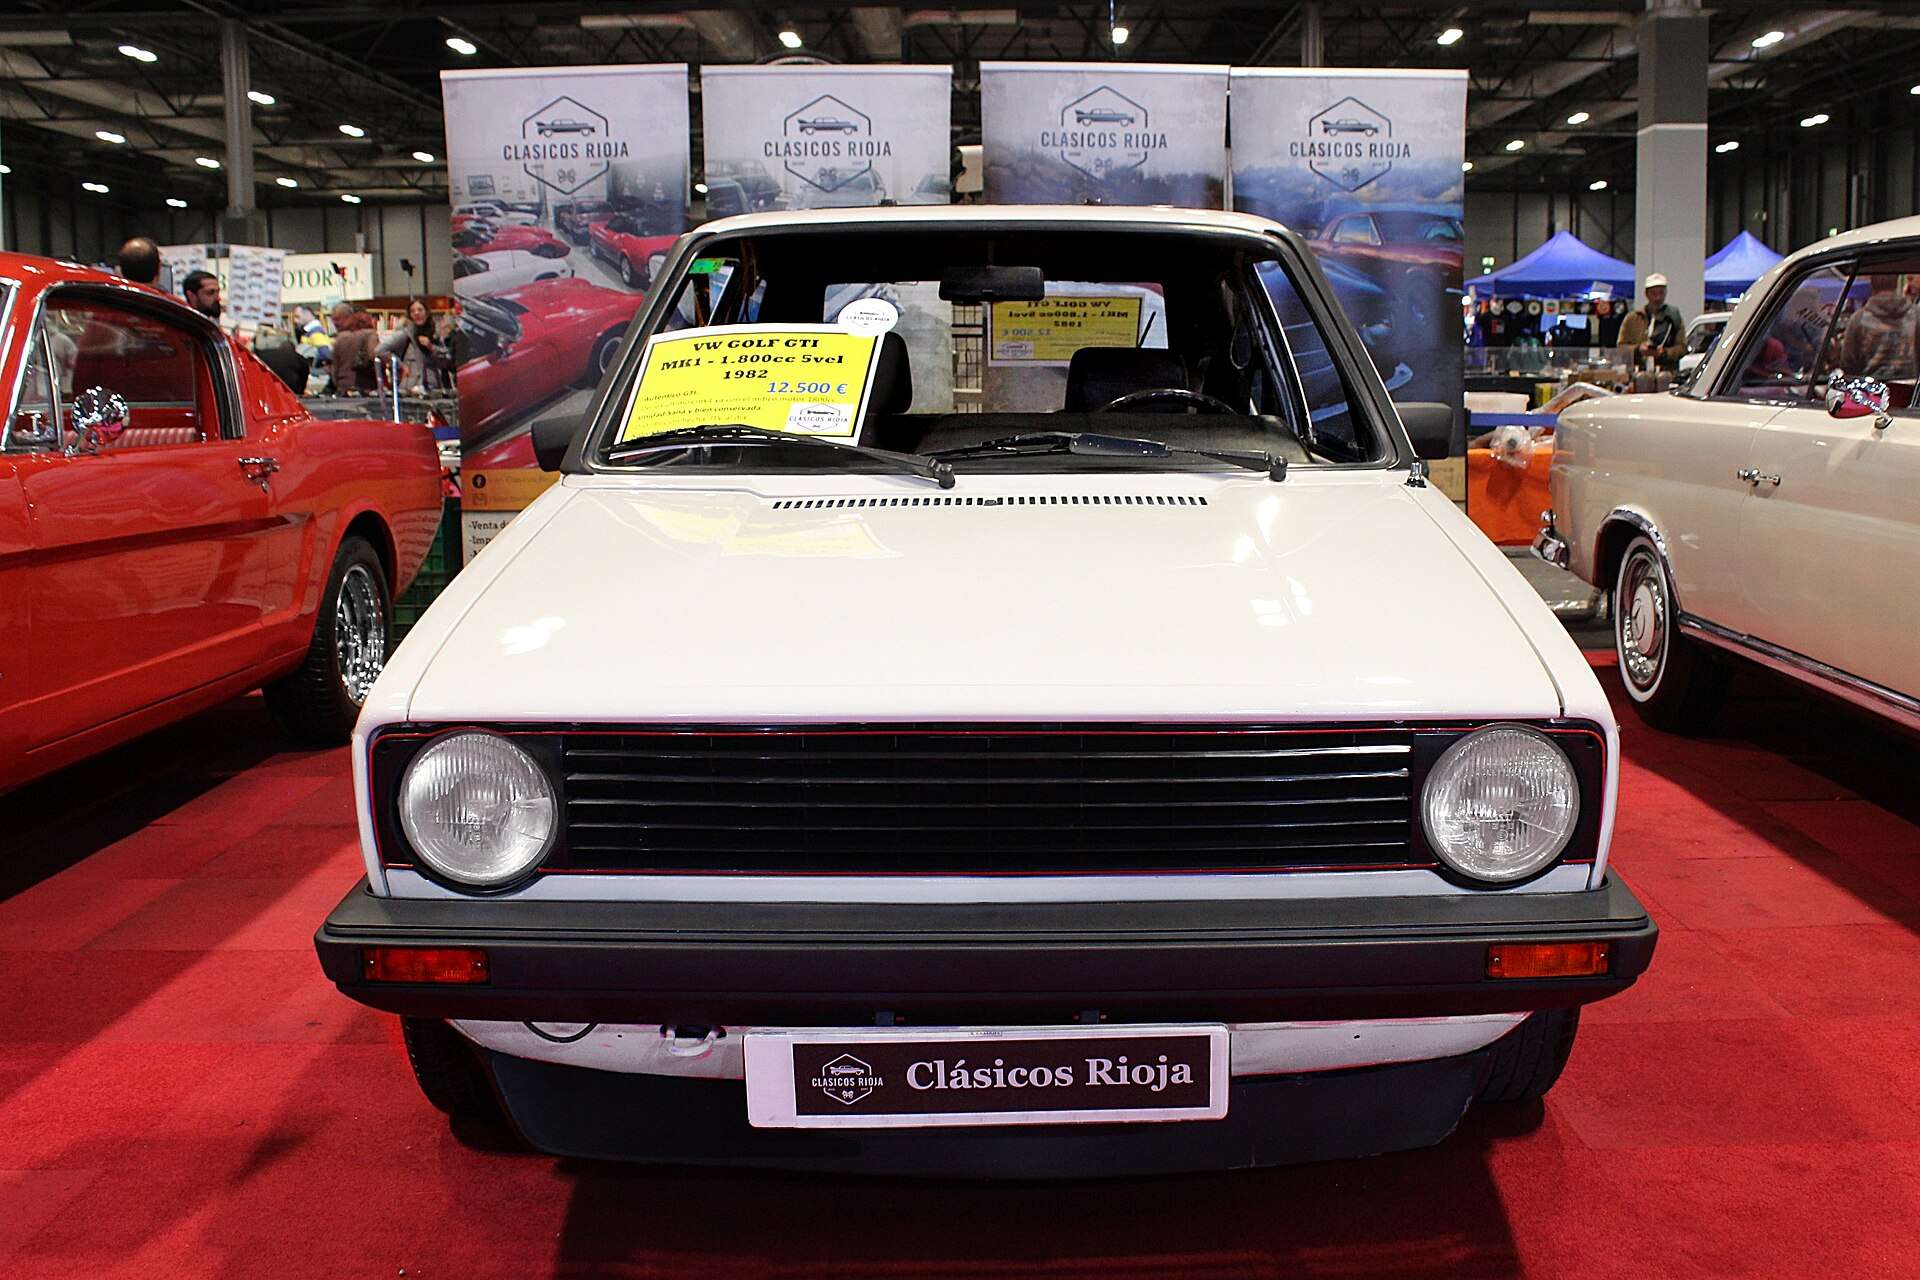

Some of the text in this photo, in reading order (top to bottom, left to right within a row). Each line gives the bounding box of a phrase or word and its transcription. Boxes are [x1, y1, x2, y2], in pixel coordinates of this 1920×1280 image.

[764, 140, 892, 158] CLASICOS RIOJA
[1041, 131, 1168, 149] CLASICOS RIOJA
[503, 141, 629, 161] CLASICOS RIOJA
[1289, 141, 1411, 159] CLASICOS RIOJA
[282, 267, 333, 289] OTOR
[693, 339, 820, 351] VW GOLF GTI
[660, 357, 702, 371] MK1
[721, 354, 796, 364] 1.800cc
[723, 369, 769, 379] 1982
[767, 382, 848, 394] 12.500 €
[811, 1077, 884, 1087] CLASICOS RIOJA
[906, 1055, 1194, 1092] Clásicos Rioja
